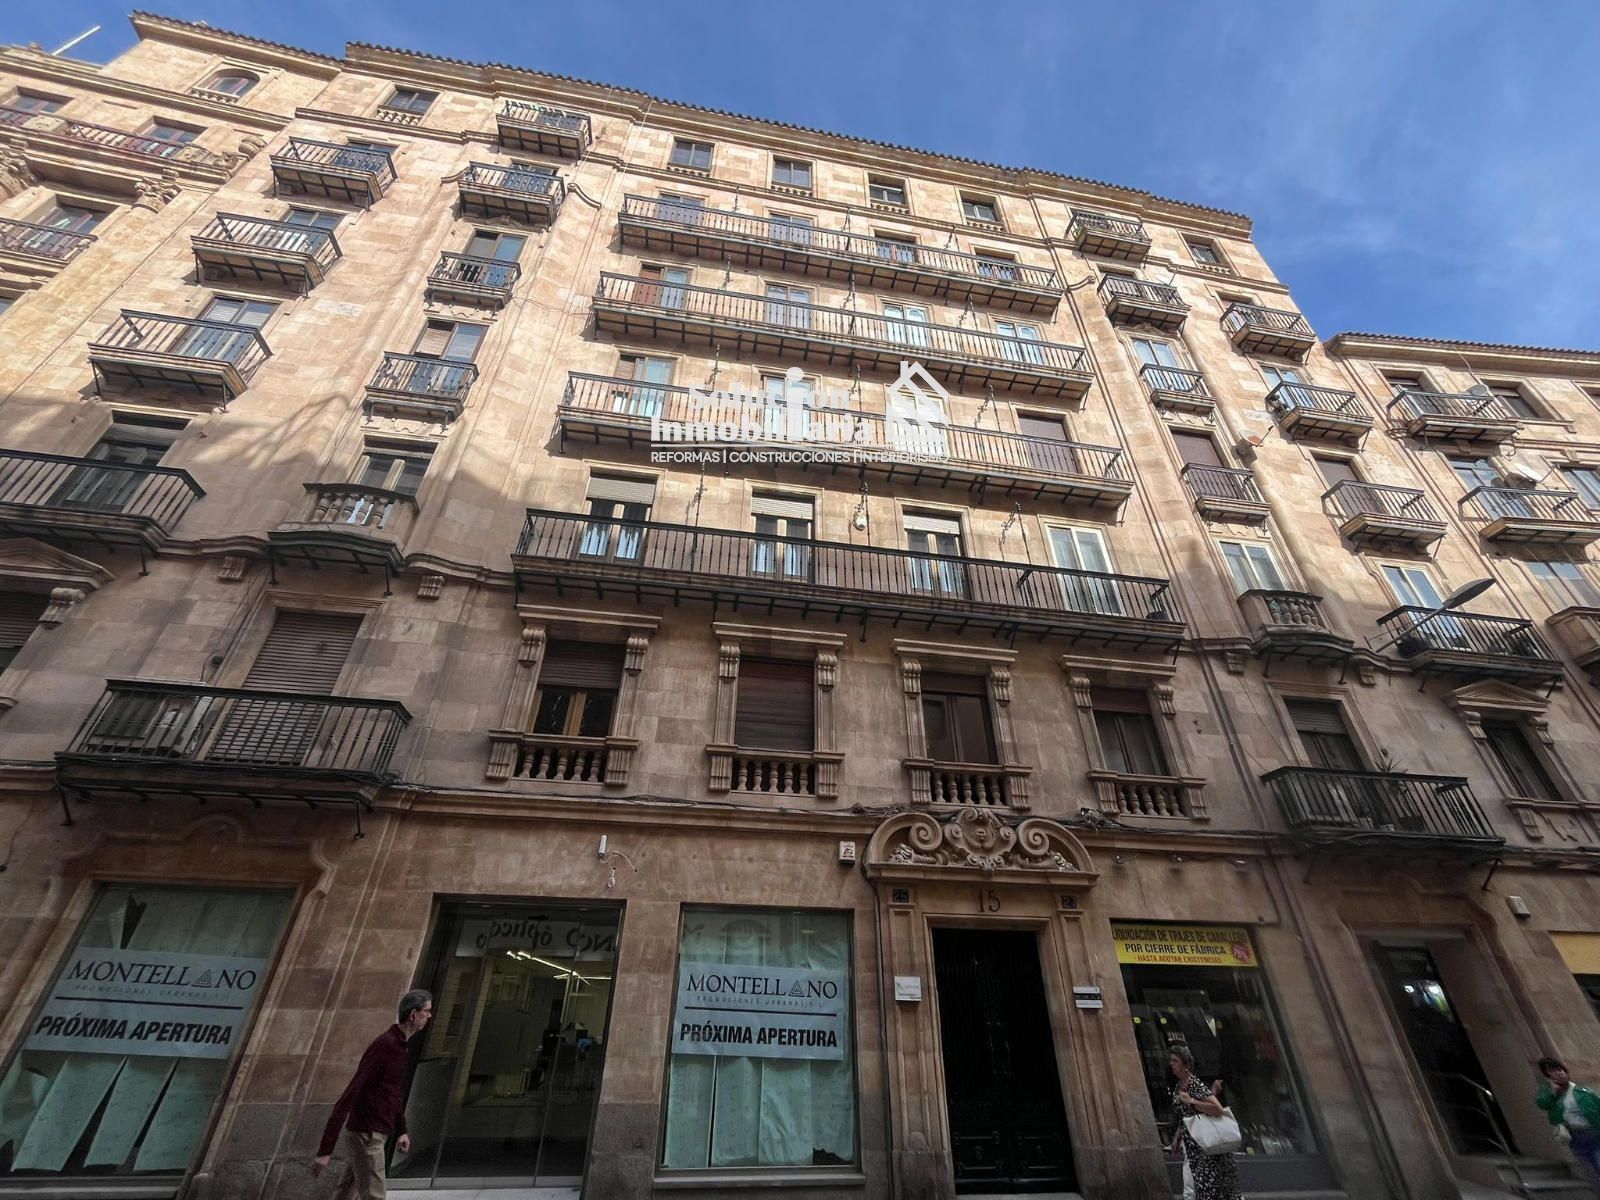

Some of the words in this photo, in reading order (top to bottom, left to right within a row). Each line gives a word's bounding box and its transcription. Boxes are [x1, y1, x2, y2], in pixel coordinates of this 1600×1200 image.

[977, 890, 1001, 913] 15
[1112, 927, 1157, 941] LIQUIDACIÓN
[1158, 929, 1169, 941] DE
[1170, 930, 1195, 943] TRAJES
[1196, 931, 1205, 943] DE
[1125, 943, 1142, 953] POR
[1145, 944, 1175, 954] CIERRE
[1177, 945, 1188, 954] DE
[1190, 943, 1227, 955] FÁBRICA
[1138, 955, 1158, 963] HASTA
[66, 960, 257, 990] MONTELLANO
[686, 973, 838, 999] MONTELLANO
[35, 1012, 128, 1039] PRÓXIMA
[128, 1021, 232, 1045] APERTURA
[680, 1020, 752, 1044] PRÓXIMA
[757, 1027, 837, 1047] APERTURA
